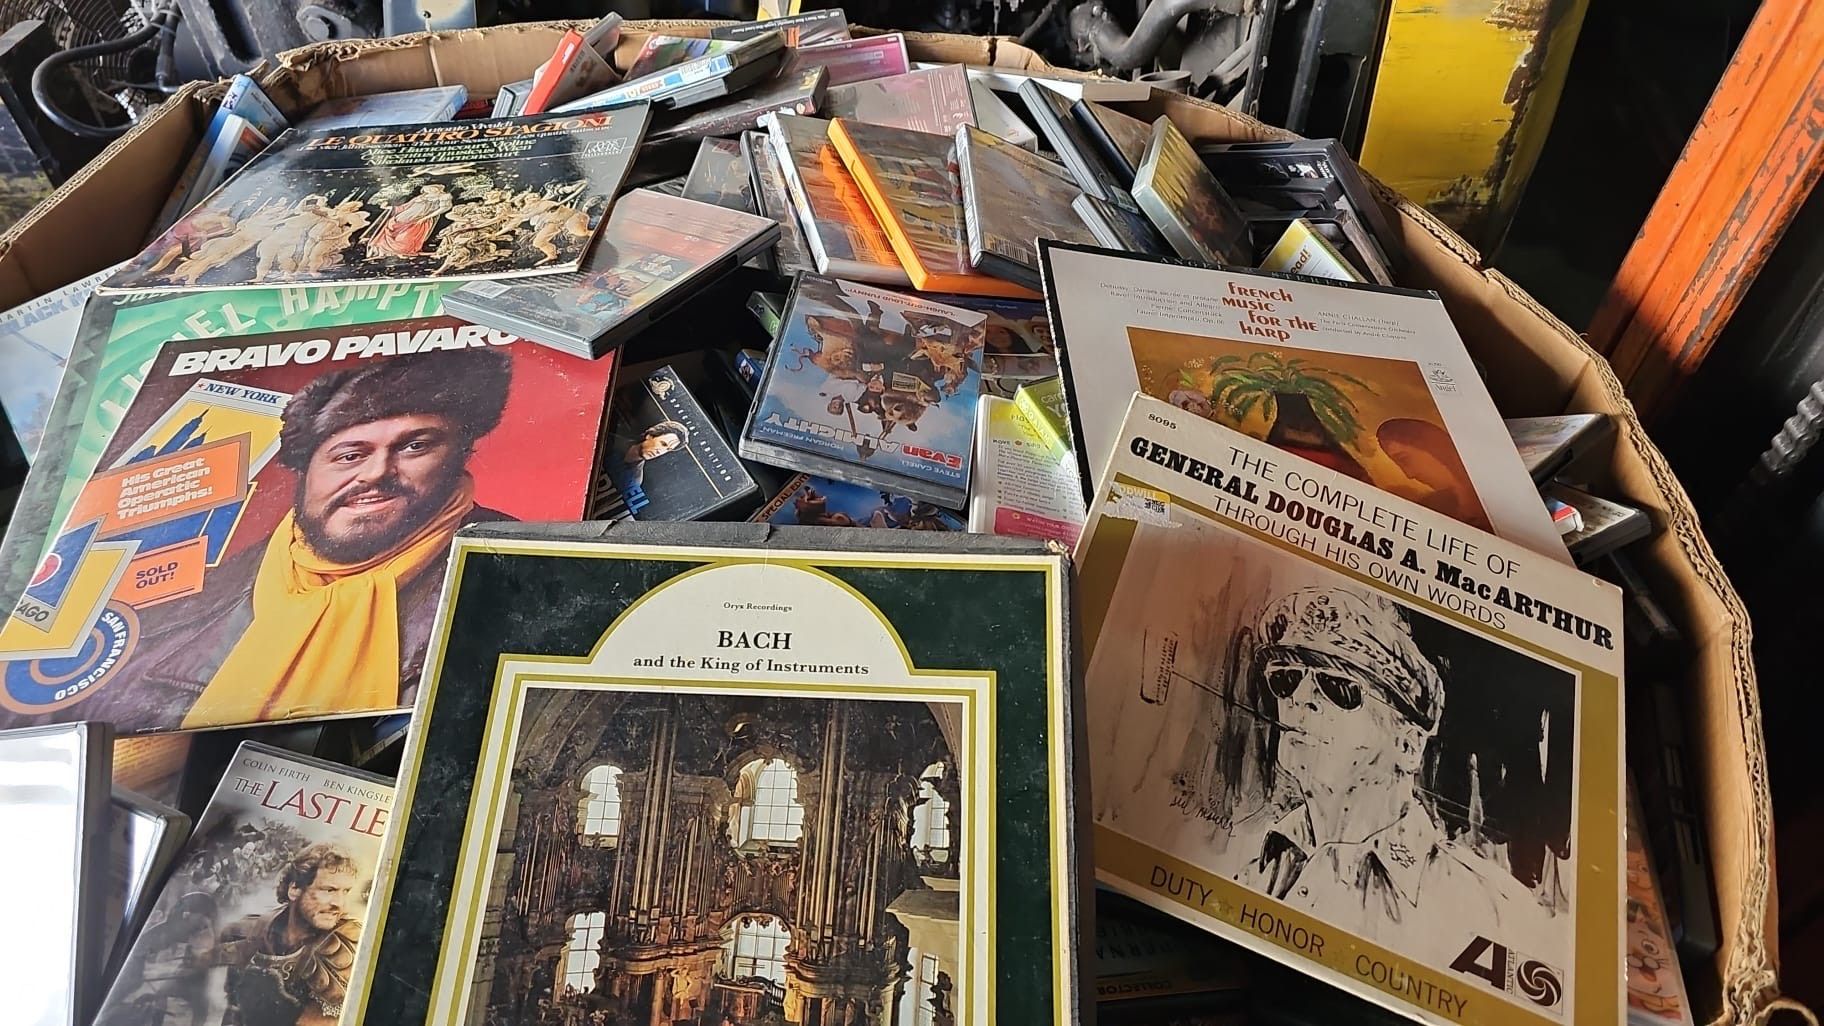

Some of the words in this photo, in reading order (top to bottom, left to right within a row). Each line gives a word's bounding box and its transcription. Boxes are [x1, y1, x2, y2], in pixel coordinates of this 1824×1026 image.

[305, 136, 346, 147] LE
[349, 129, 482, 145] QUATTRO
[484, 116, 616, 137] STAGIONI
[417, 125, 469, 134] Antonio
[472, 121, 514, 130] Vivaldi
[361, 148, 397, 156] Alice
[430, 151, 520, 162] Harnoncourt
[1290, 247, 1312, 273] ead!
[62, 267, 121, 296] LAWREN
[281, 283, 442, 318] HAMPT
[168, 339, 331, 377] BRAVO
[333, 325, 520, 360] PAVARO
[203, 383, 239, 397] NEW
[240, 388, 282, 404] YORK
[760, 425, 807, 444] FREEMAN
[764, 412, 900, 454] ALMIGHTY
[1148, 413, 1178, 431] 8095
[669, 398, 700, 437] SPECIAL
[700, 440, 732, 482] EDITION
[808, 434, 845, 451] MORGAN
[902, 445, 964, 470] Evan
[930, 464, 962, 479] STEVE
[119, 467, 211, 499] American
[121, 467, 150, 488] His
[152, 457, 204, 480] Great
[116, 487, 213, 520] Triumphs!
[117, 480, 201, 510] Operatic
[761, 491, 793, 520] SPECIAL
[1130, 436, 1259, 505] GENERAL
[1264, 489, 1394, 560] DOUGLAS
[1400, 549, 1426, 575] A.
[1228, 446, 1279, 482] THE
[1284, 470, 1419, 542] COMPLETE
[1426, 527, 1479, 566] LIFE
[1486, 552, 1521, 579] OF
[135, 561, 179, 580] SOLD
[1213, 495, 1317, 553] THROUGH
[1324, 541, 1362, 571] HIS
[1368, 560, 1420, 595] OWN
[1427, 584, 1507, 631] WORDS
[135, 572, 176, 589] OUT!
[723, 601, 744, 611] Oryx
[746, 602, 793, 612] Recordings
[717, 630, 793, 650] BACH
[54, 634, 128, 701] FRANCISCO
[633, 655, 664, 668] and
[670, 657, 696, 669] the
[701, 657, 740, 674] King
[746, 659, 763, 671] of
[767, 659, 869, 675] Instruments
[243, 758, 276, 776] COLIN
[278, 766, 311, 783] FIRTH
[323, 779, 345, 792] BEN
[347, 785, 394, 804] KINGSLE
[233, 777, 265, 798] THE
[261, 780, 352, 825] LAST
[1150, 865, 1213, 907] DUTY
[1239, 903, 1325, 957] HONOR
[1355, 953, 1469, 1018] COUNTRY
[1506, 948, 1516, 994] ATLANTIC
